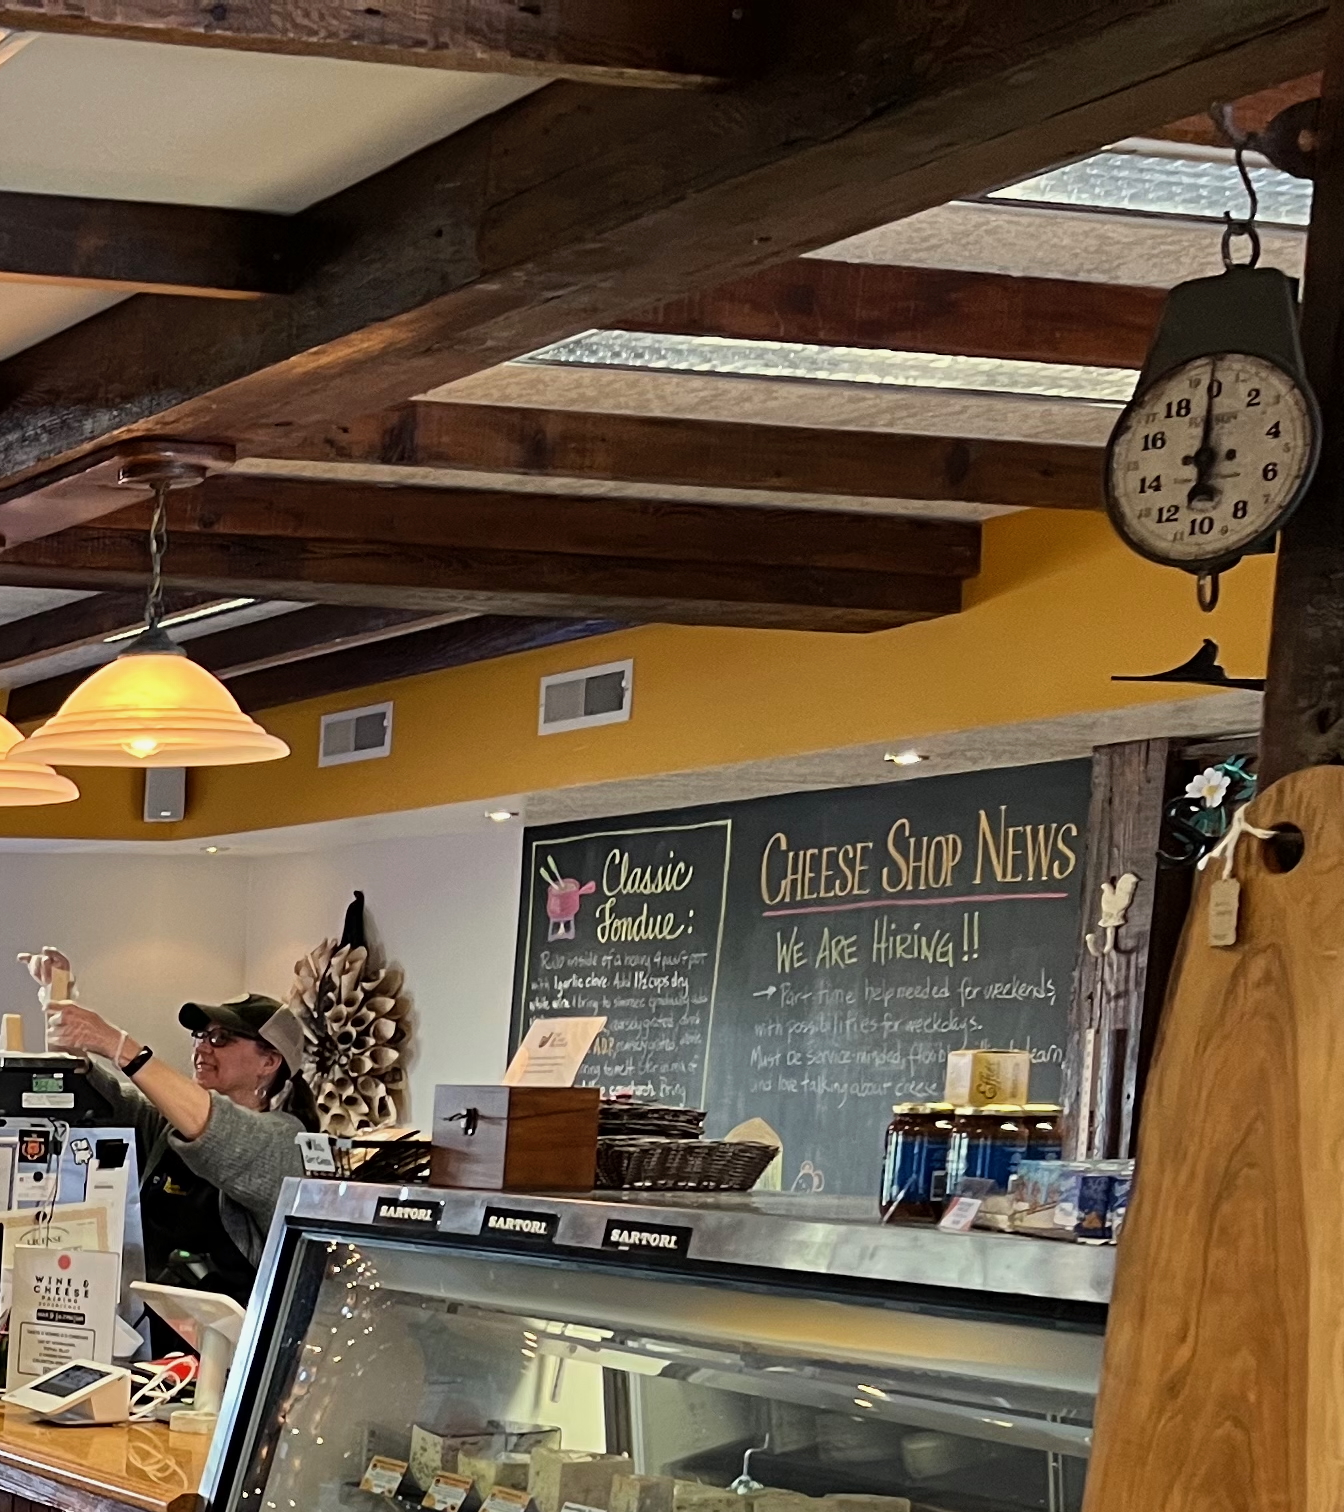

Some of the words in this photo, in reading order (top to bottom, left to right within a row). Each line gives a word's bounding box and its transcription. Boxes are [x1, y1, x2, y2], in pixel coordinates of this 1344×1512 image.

[1246, 388, 1261, 407] 2
[1164, 398, 1191, 418] 18
[1265, 420, 1281, 439] 4
[1141, 431, 1166, 451] 16
[1262, 462, 1278, 481] 6
[1138, 474, 1162, 494] 14
[1156, 504, 1179, 523] 12
[1232, 500, 1248, 520] 8
[1189, 516, 1214, 536] 10
[761, 833, 873, 905] CHEESE
[882, 818, 961, 892] SHOP
[973, 805, 1078, 884] NEWS
[603, 849, 693, 897] Classic
[776, 926, 807, 973] WE
[815, 927, 858, 969] ARE
[648, 975, 670, 994] cups
[671, 970, 688, 1000] dry
[865, 978, 893, 1007] help
[896, 975, 950, 999] needed
[957, 976, 981, 1007] for
[754, 1015, 782, 1037] with
[879, 1012, 903, 1039] for
[750, 1045, 782, 1069] Must
[786, 1050, 802, 1065] be
[778, 1074, 798, 1093] love
[801, 1068, 848, 1108] talking
[380, 1205, 433, 1222] SARTORI
[488, 1215, 547, 1235] SARTORI
[611, 1228, 678, 1249] SARTORI
[35, 1275, 72, 1287] WINE
[33, 1285, 89, 1299] CHEESE
